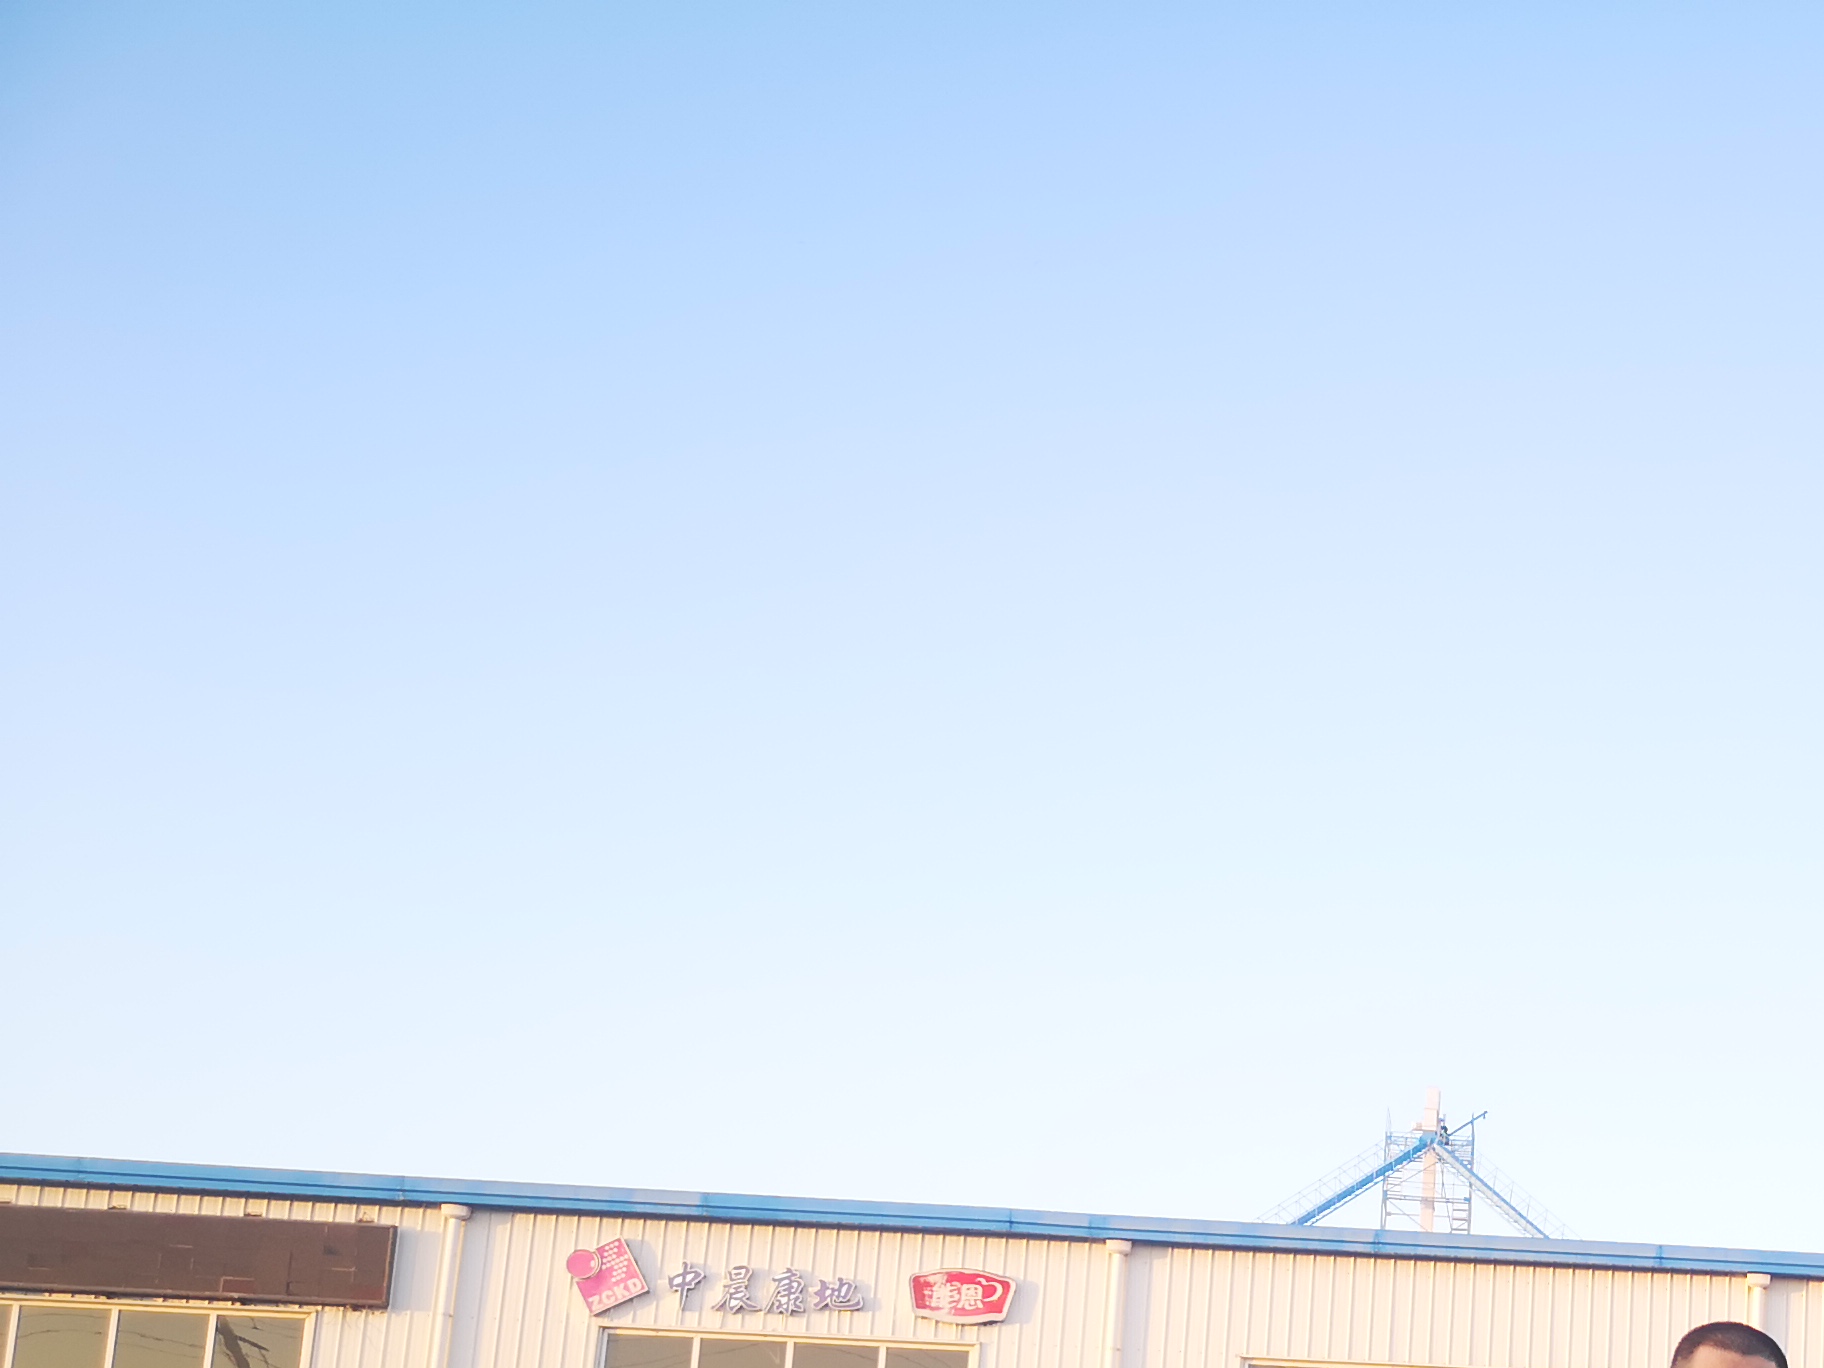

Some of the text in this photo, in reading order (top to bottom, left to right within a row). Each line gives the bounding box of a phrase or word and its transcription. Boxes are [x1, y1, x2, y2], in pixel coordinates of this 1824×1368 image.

[588, 1277, 643, 1311] ZCKD
[668, 1260, 864, 1317] 中晨康地
